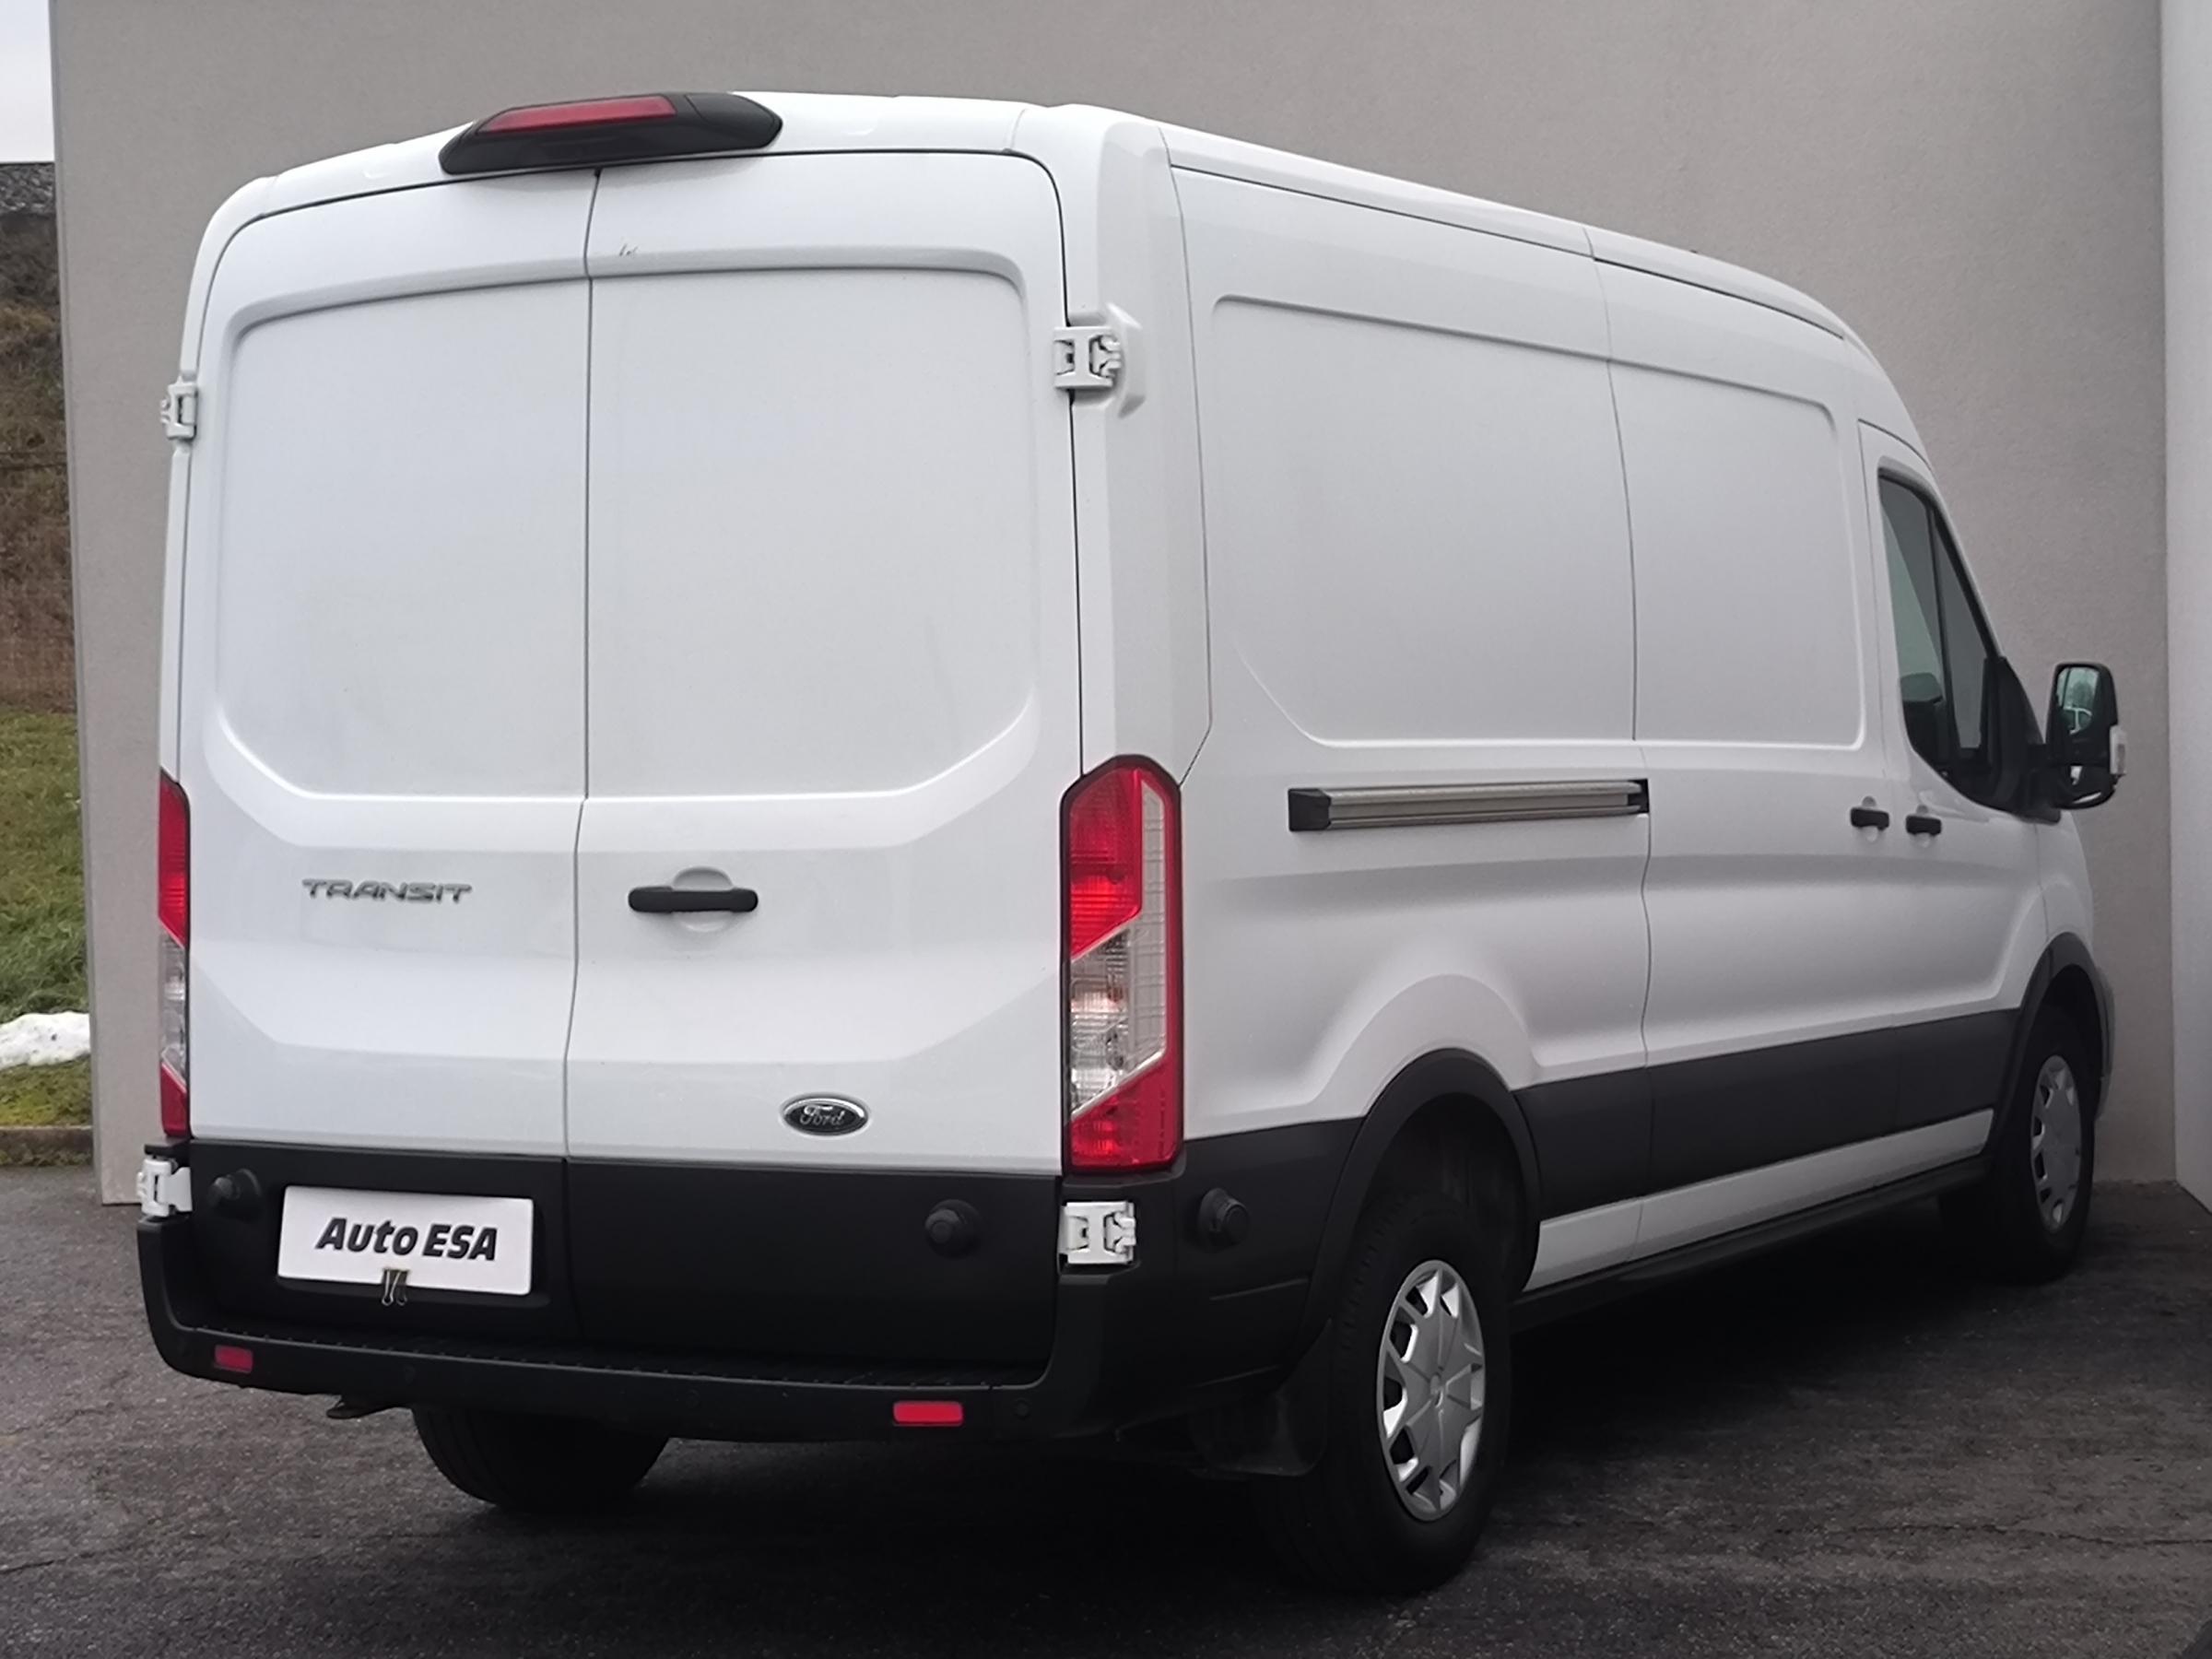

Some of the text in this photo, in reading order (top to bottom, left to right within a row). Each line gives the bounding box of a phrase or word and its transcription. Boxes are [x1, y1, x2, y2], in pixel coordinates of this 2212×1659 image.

[302, 878, 472, 903] TRANSIT
[800, 1105, 846, 1125] Ford
[315, 1217, 498, 1261] Auto ESA
